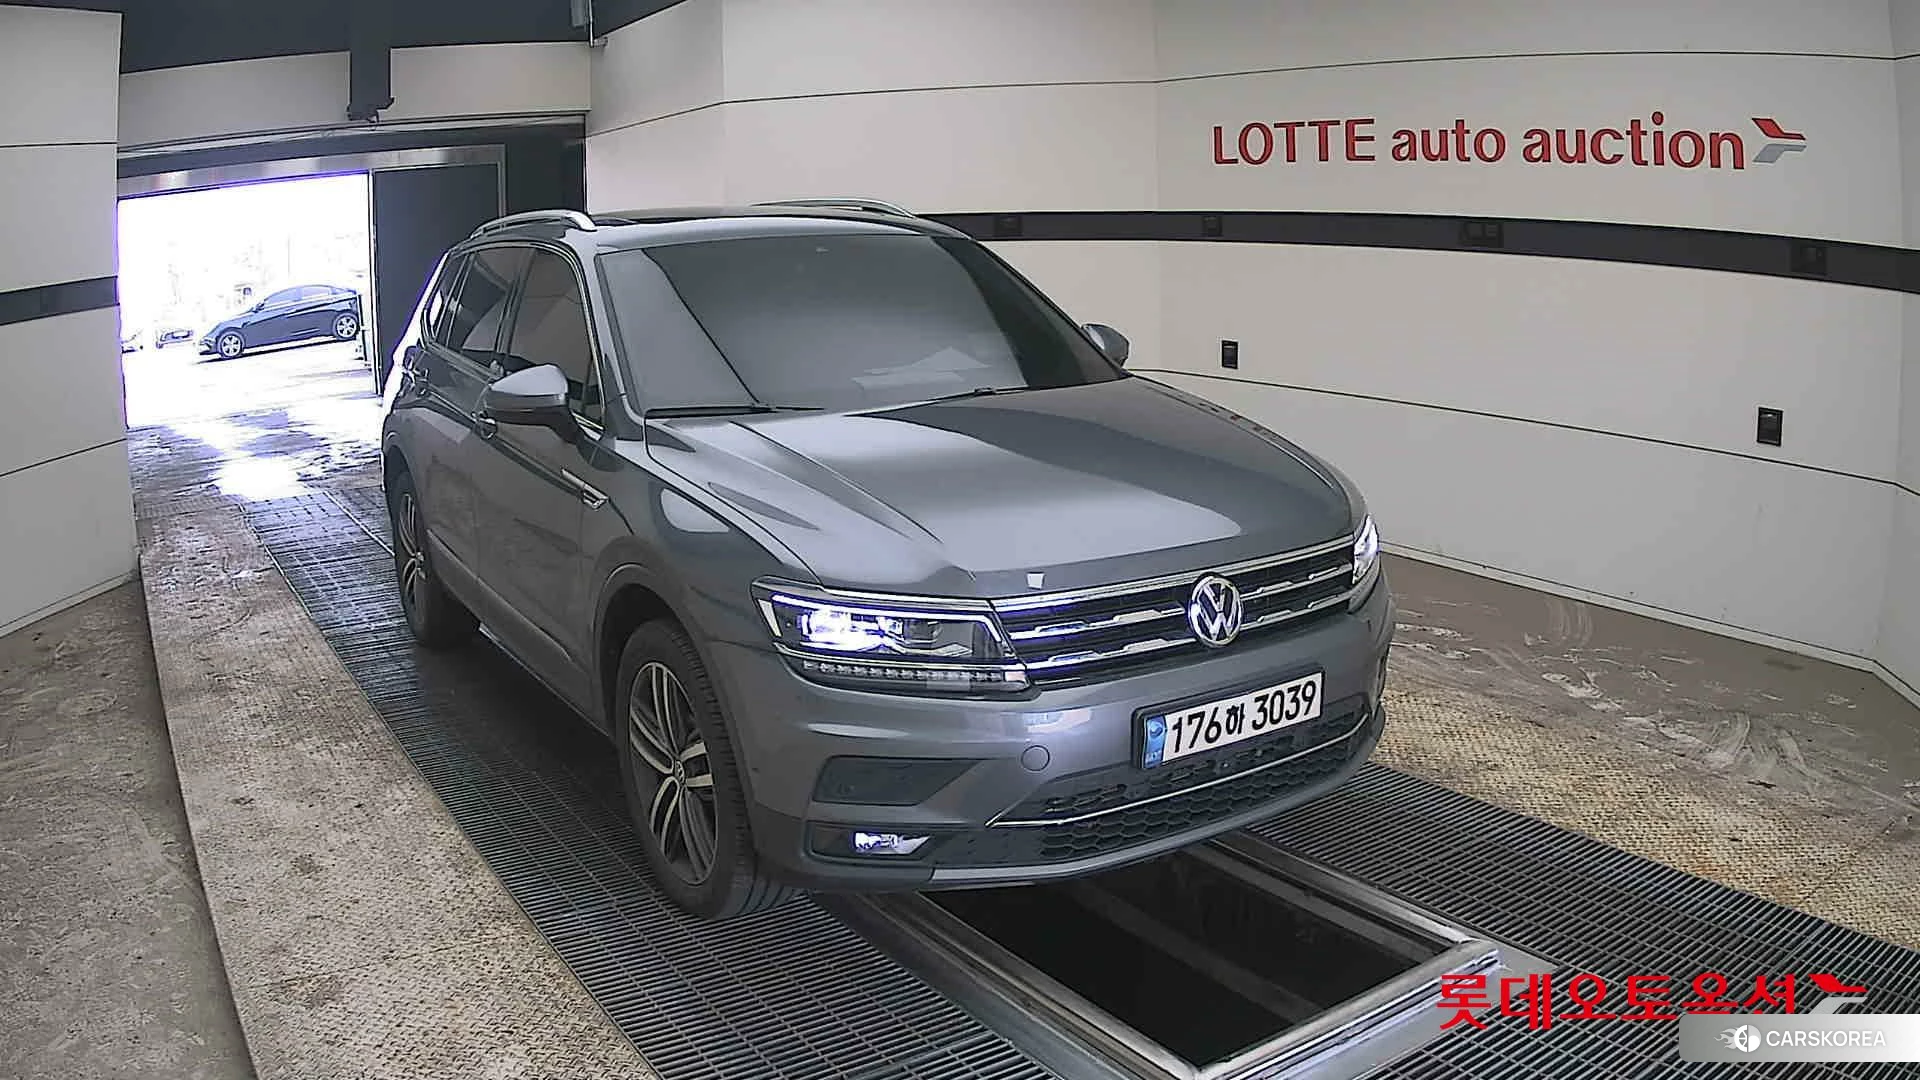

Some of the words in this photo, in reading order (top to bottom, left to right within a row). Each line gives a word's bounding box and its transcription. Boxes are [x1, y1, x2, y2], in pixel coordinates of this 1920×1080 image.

[1213, 118, 1375, 165] LOTTE
[1391, 119, 1506, 163] auto
[1522, 111, 1745, 169] auction
[1190, 575, 1243, 646] VW
[1171, 702, 1246, 753] 176하
[1251, 680, 1317, 731] 3039
